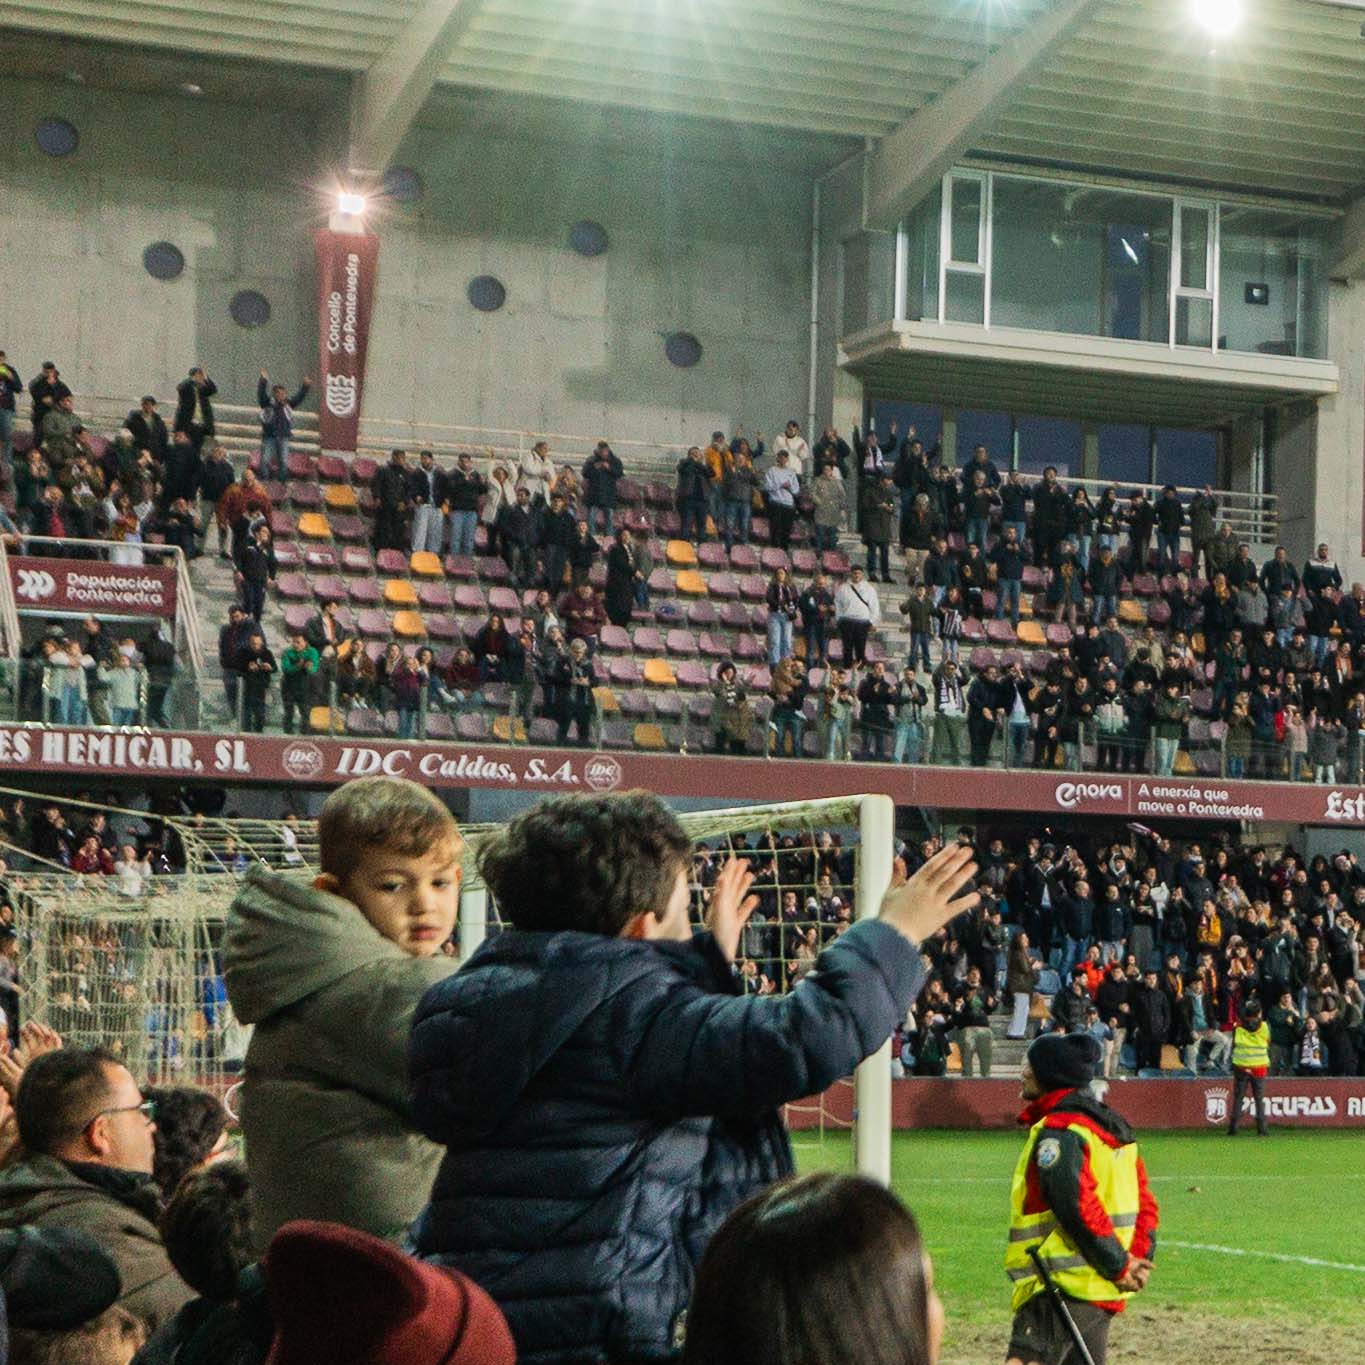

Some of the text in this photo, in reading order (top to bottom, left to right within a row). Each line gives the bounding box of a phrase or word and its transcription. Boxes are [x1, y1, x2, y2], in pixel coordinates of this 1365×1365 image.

[343, 253, 359, 354] de Pontevedra
[328, 291, 341, 352] Concello
[66, 572, 163, 592] Deputación
[66, 586, 163, 606] Pontevedra
[41, 731, 204, 772] HEMICAR,
[215, 738, 250, 773] SL
[334, 747, 580, 784] IDC Caldas, S.A.
[1138, 784, 1229, 803] A enerxía que
[1138, 802, 1264, 818] move o Pontevedra
